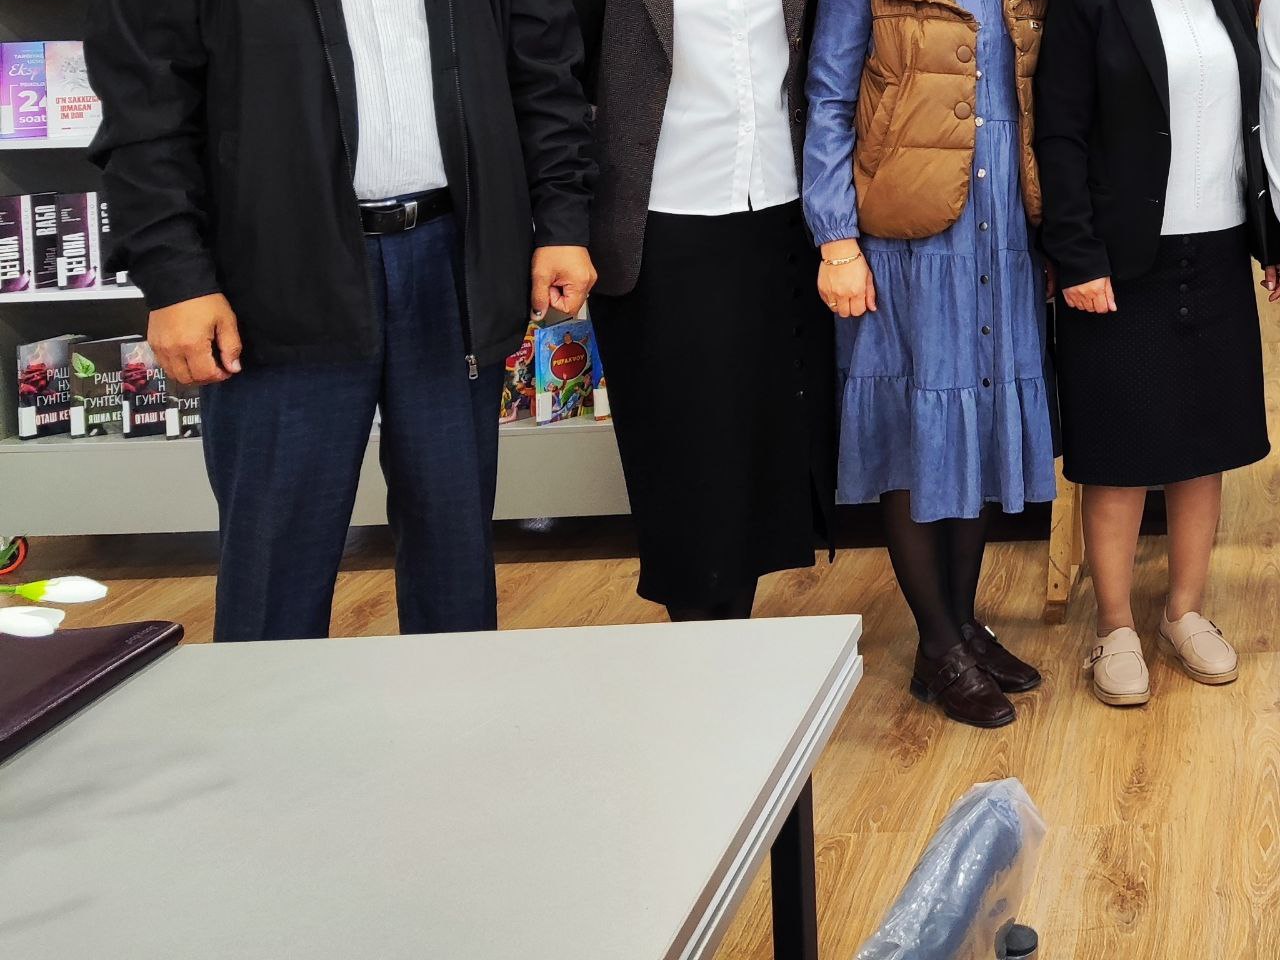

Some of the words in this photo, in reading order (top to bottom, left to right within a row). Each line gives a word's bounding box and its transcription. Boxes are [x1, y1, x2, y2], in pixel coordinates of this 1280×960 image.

[34, 204, 57, 236] ВАБО
[59, 409, 70, 421] КЕ
[112, 410, 123, 421] КЕ
